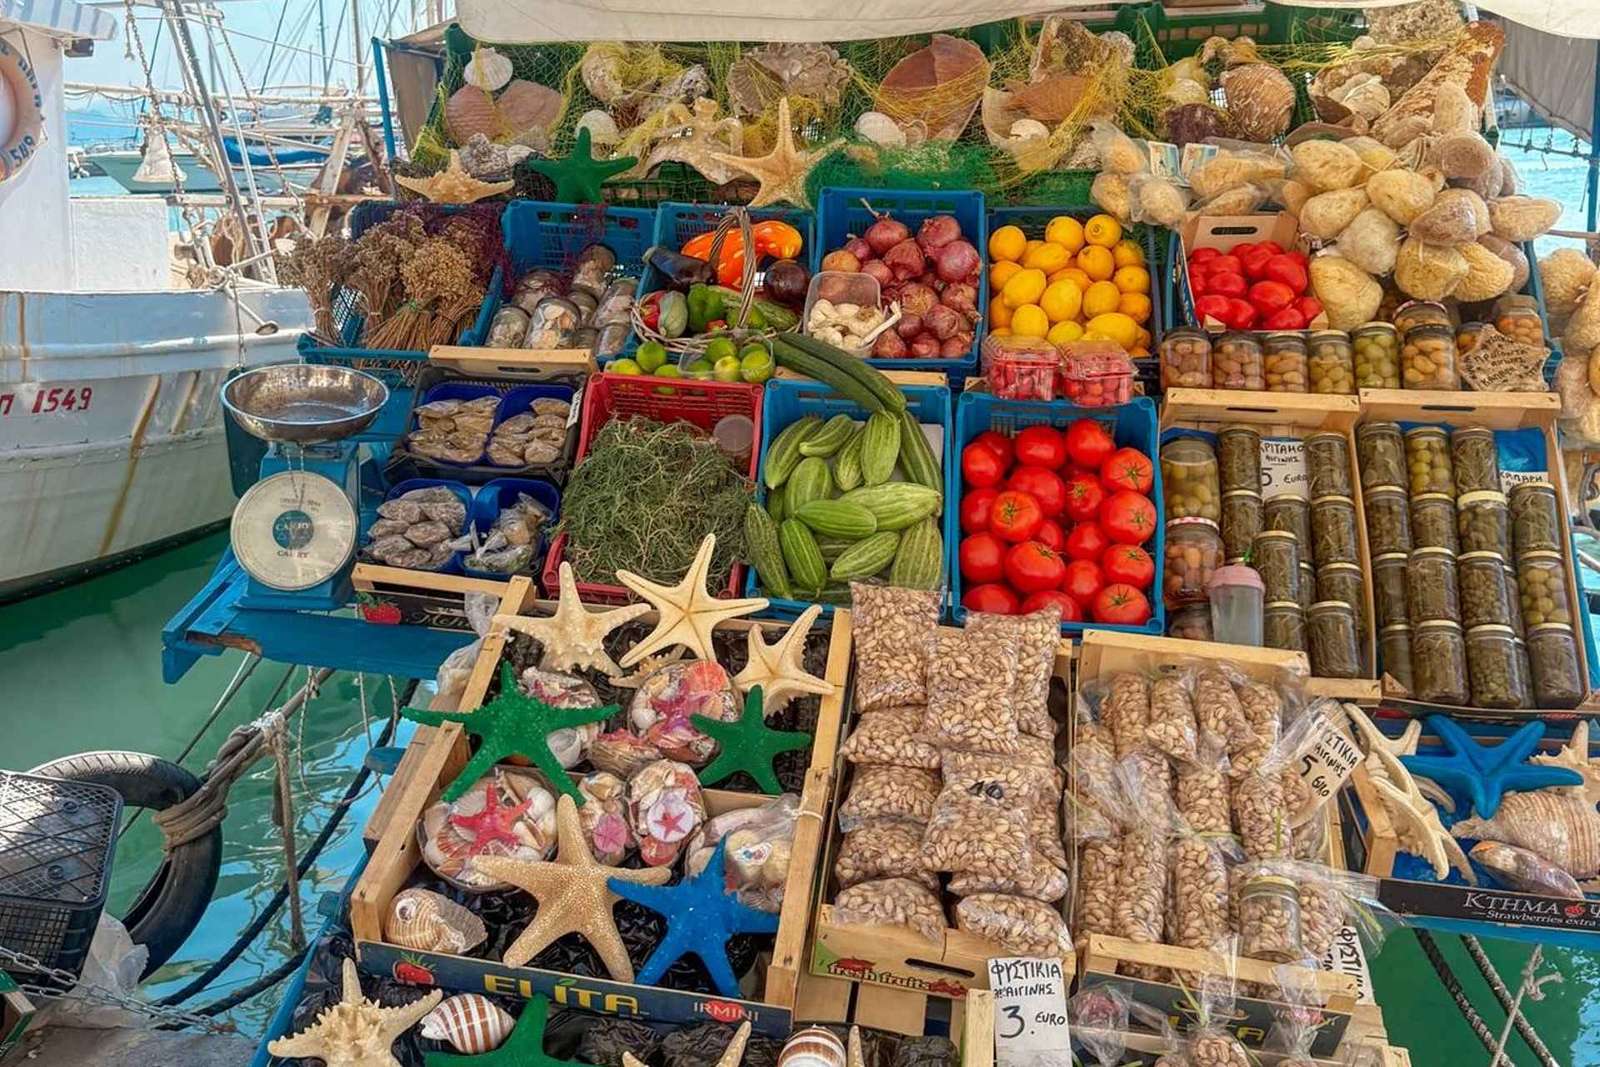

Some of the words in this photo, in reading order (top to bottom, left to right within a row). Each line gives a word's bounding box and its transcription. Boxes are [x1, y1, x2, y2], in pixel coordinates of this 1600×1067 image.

[32, 387, 92, 413] 1549
[1319, 722, 1359, 769] ΣΤΙΚΙΑ
[1300, 754, 1319, 777] 5
[1486, 910, 1562, 925] Strawberries
[1565, 918, 1597, 928] extra
[828, 962, 877, 982] fresh
[879, 971, 930, 990] fruits
[990, 959, 1061, 986] ΦΥΣΤΙΚΙΑ
[1336, 928, 1365, 999] ΦΥΣΤΙ
[693, 1002, 759, 1023] IRMINI
[1035, 1011, 1066, 1026] EURO
